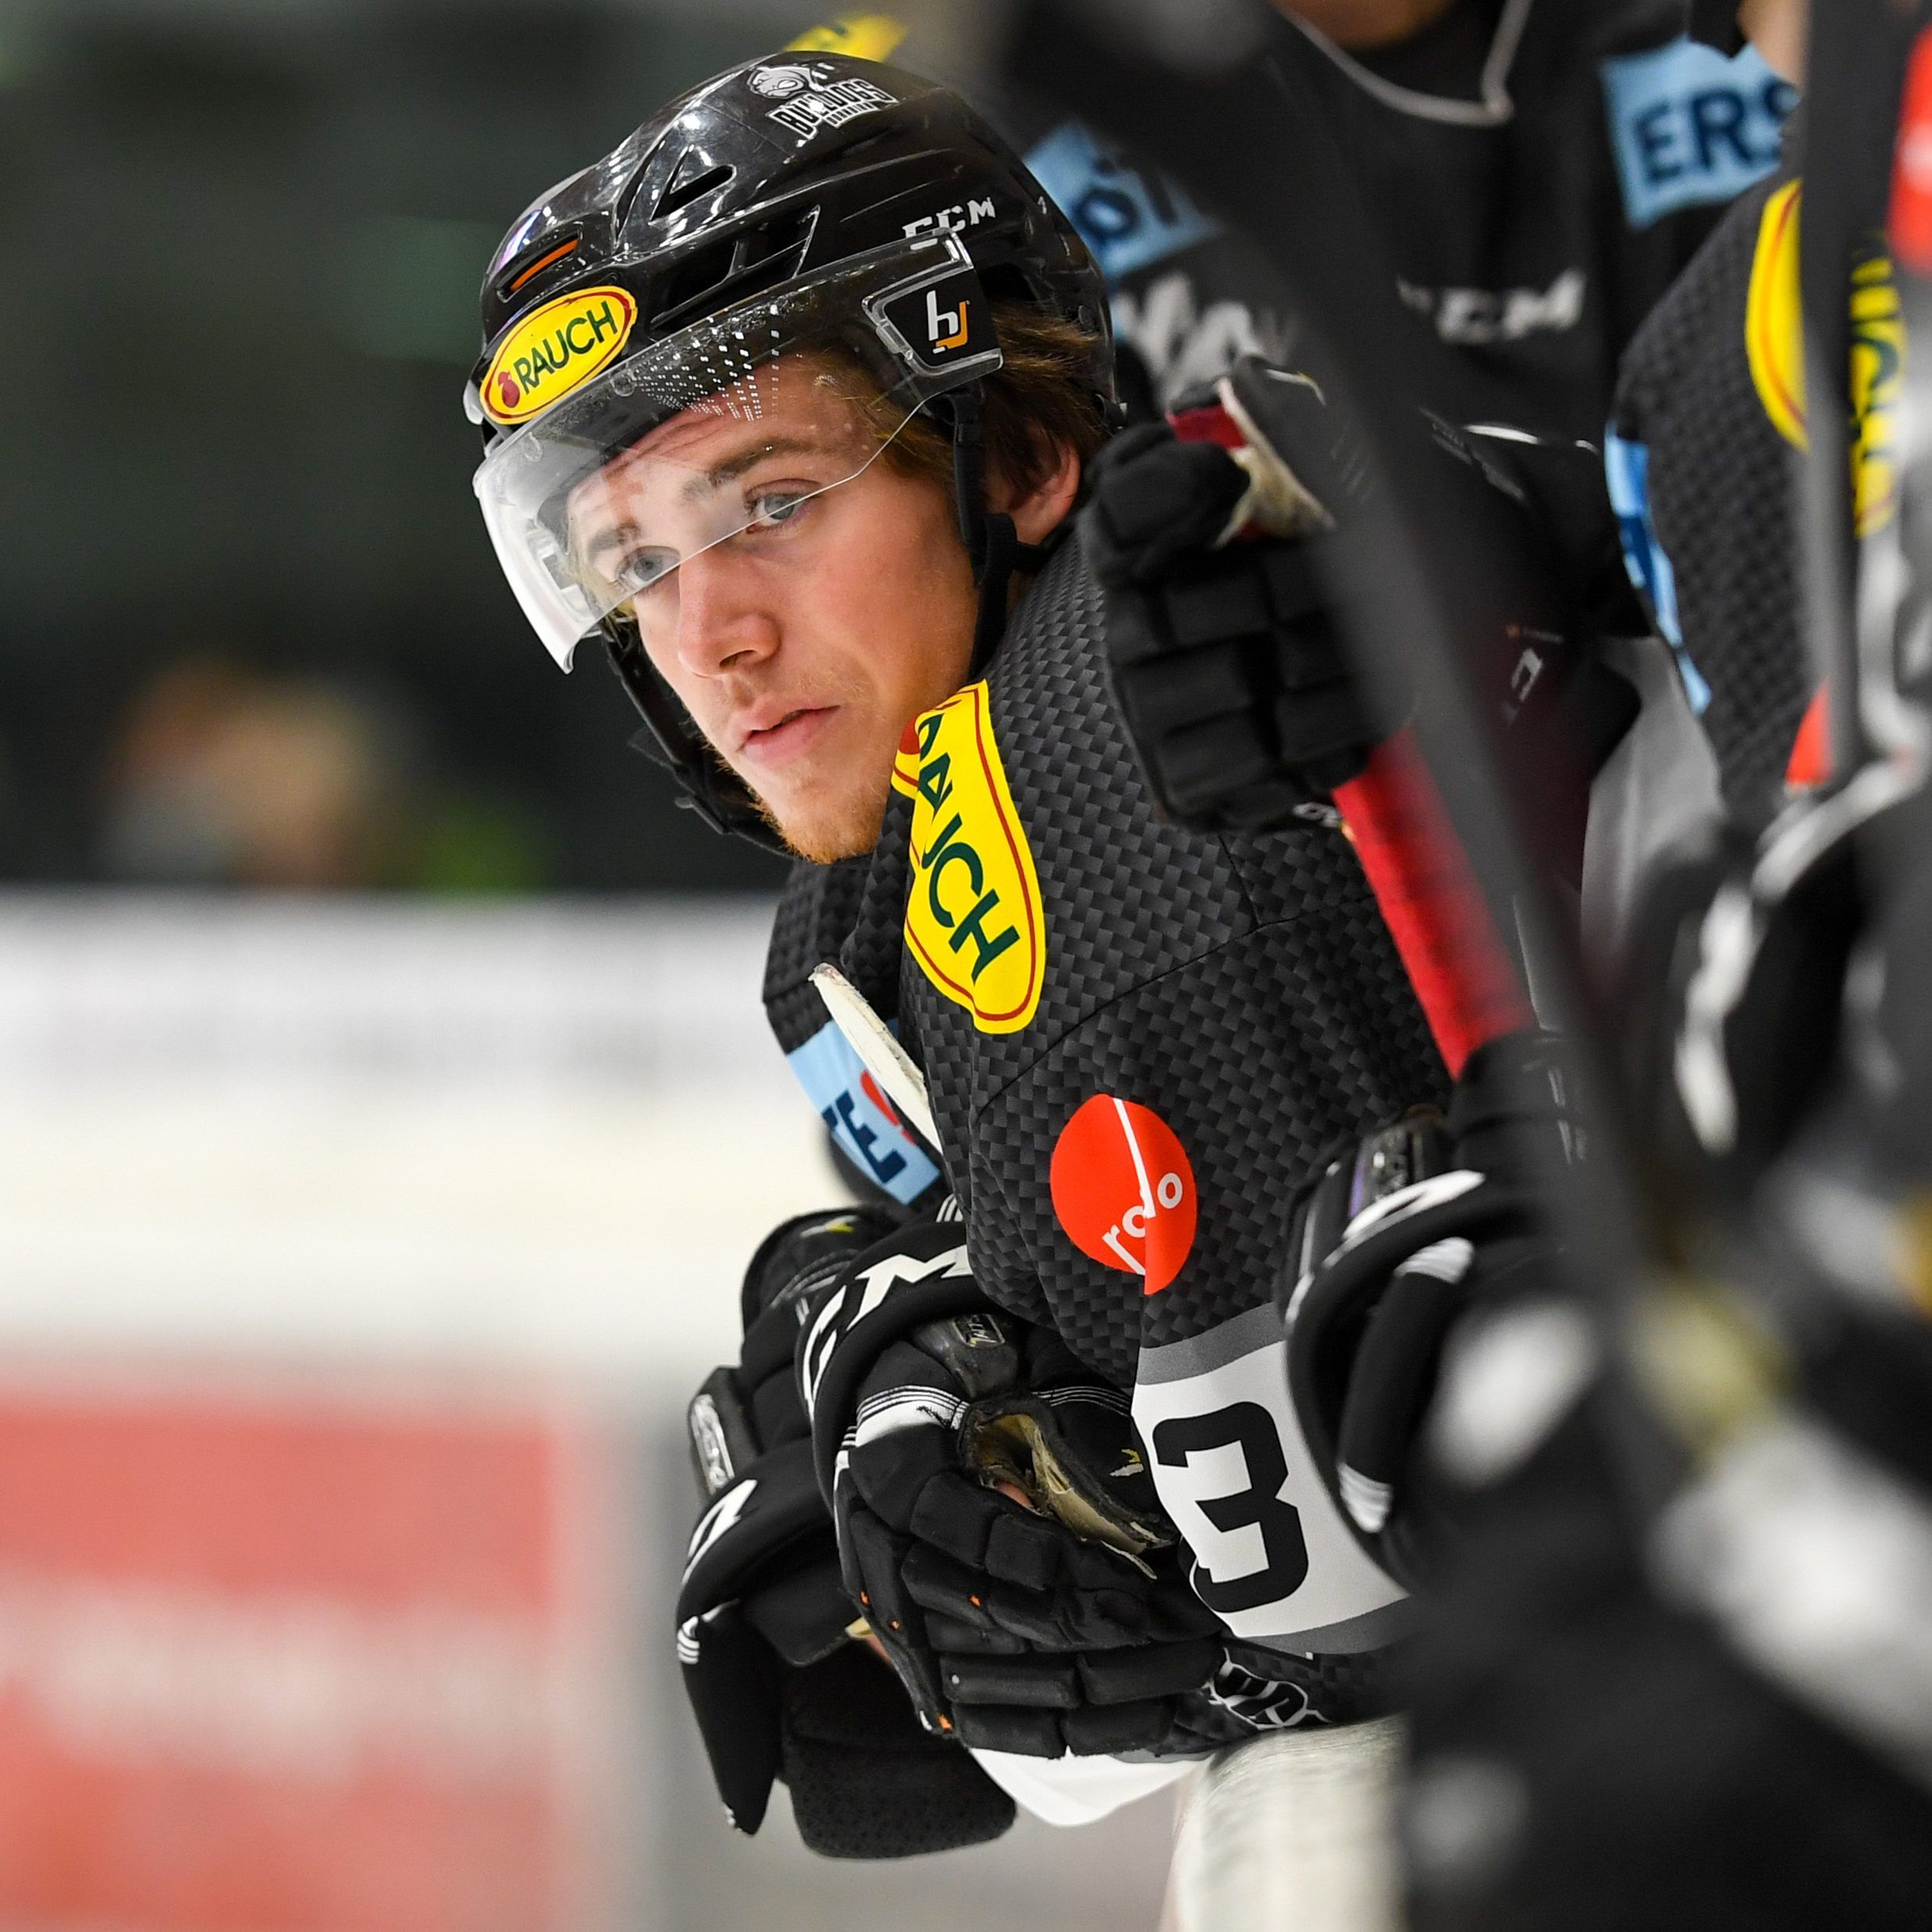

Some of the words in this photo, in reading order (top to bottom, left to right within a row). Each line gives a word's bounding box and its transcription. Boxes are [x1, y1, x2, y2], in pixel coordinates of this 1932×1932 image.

[902, 197, 996, 250] CCM
[514, 301, 618, 395] RAUCH
[1152, 1401, 1309, 1613] 3
